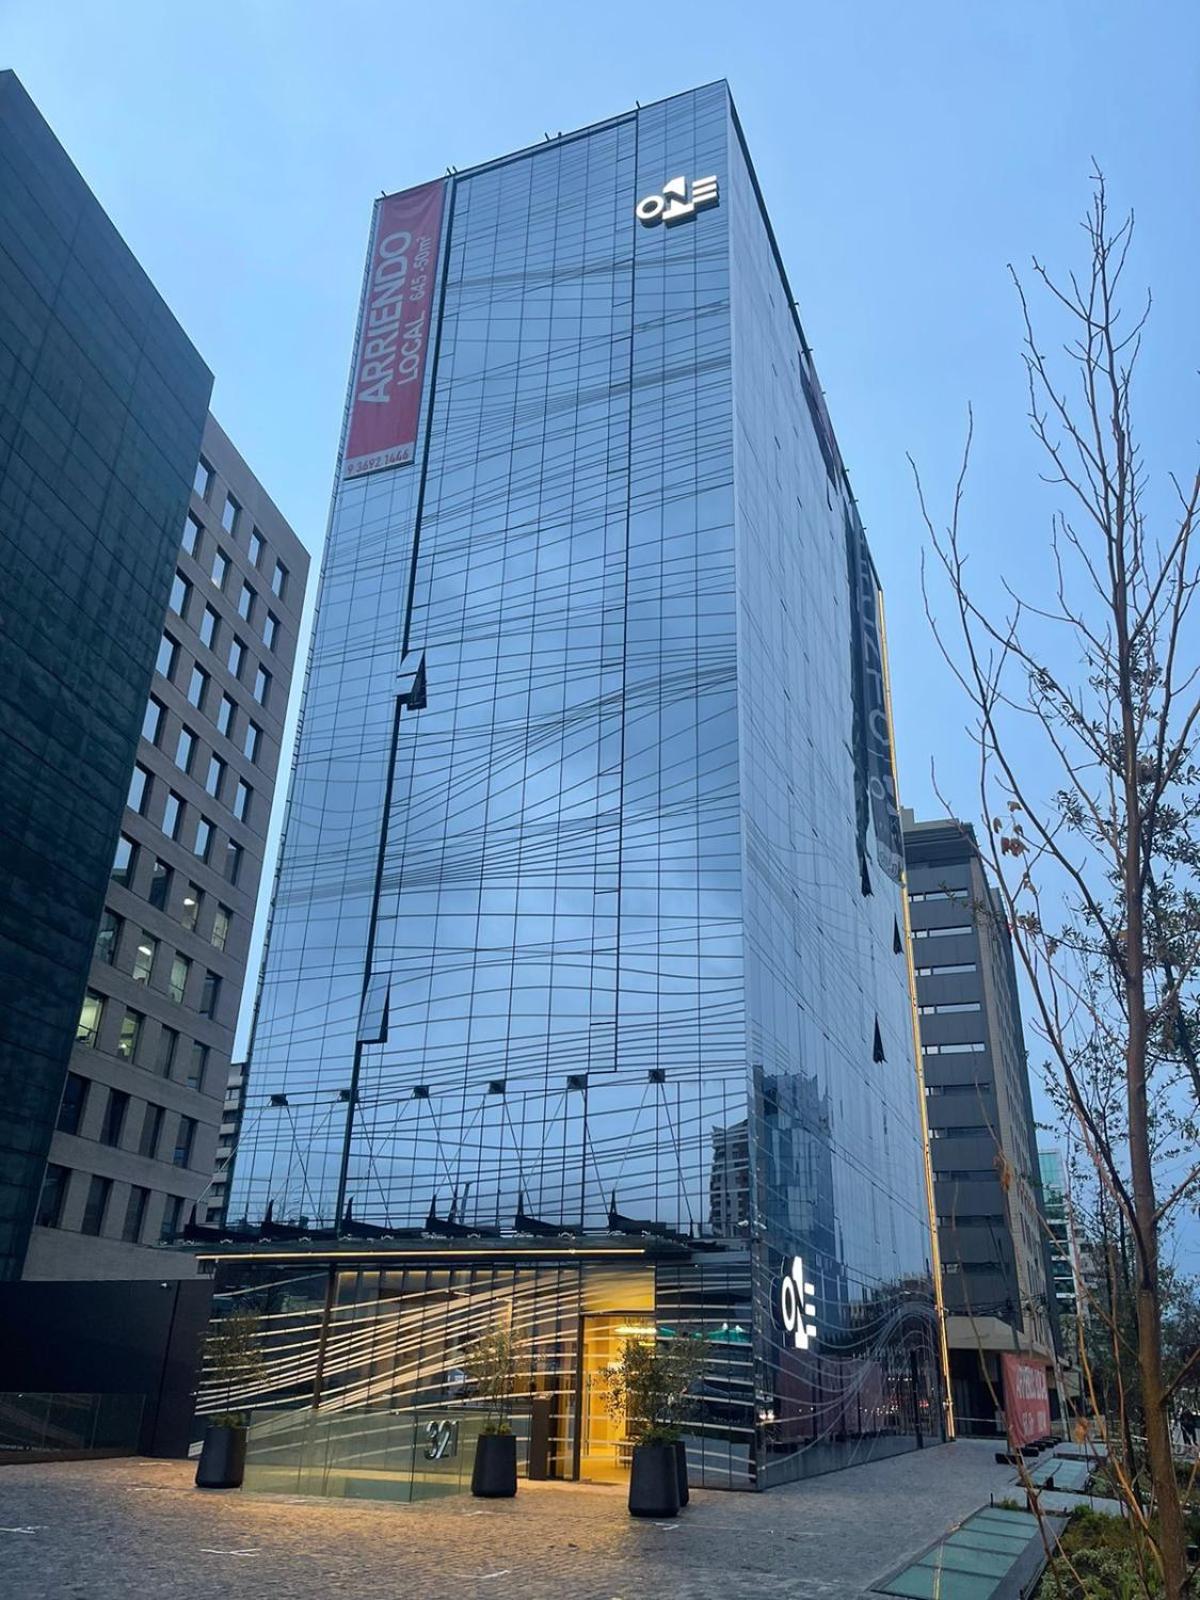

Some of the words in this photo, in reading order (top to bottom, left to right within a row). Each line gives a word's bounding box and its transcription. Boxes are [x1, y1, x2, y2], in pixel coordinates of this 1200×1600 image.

[636, 175, 718, 221] ONE
[358, 231, 411, 403] ARRIENDO
[397, 310, 426, 385] LOCAL
[781, 1256, 816, 1349] ONE
[425, 1420, 459, 1460] 321
